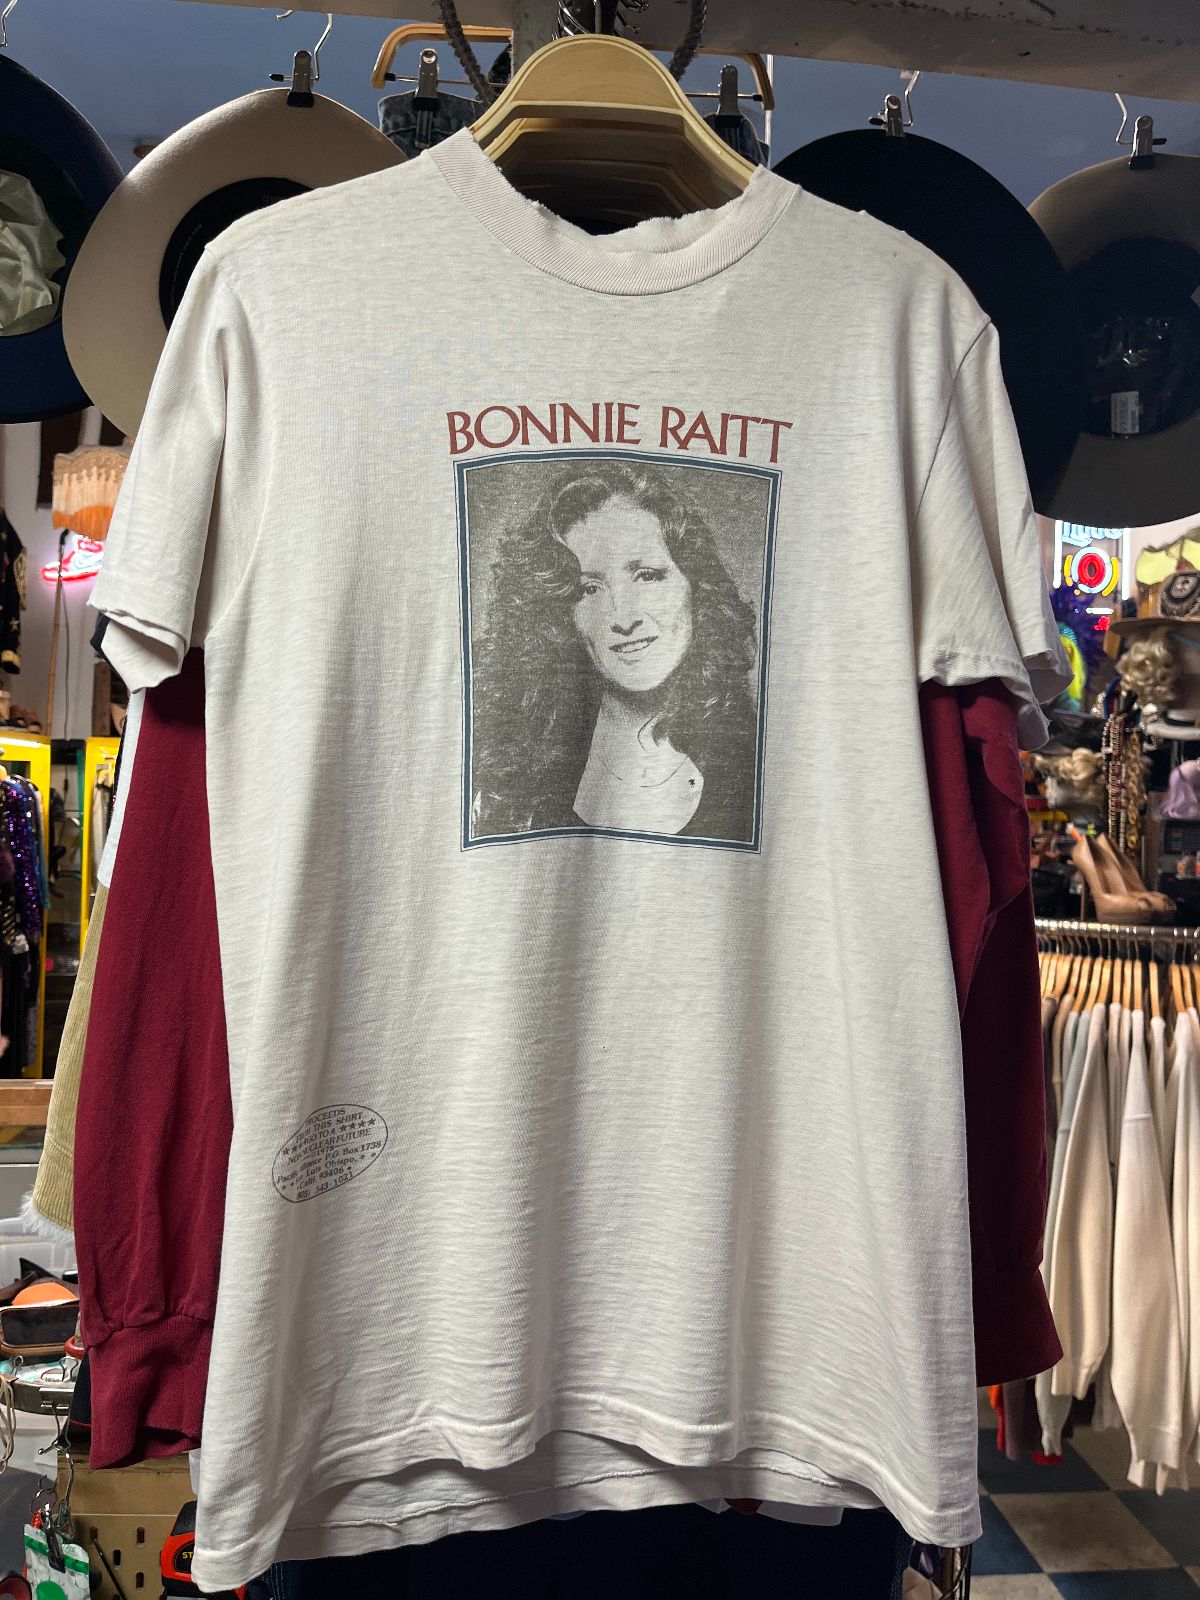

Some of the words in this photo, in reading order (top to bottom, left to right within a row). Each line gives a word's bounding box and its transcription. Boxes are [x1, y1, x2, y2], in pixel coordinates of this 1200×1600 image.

[446, 402, 641, 454] BONNIE
[659, 405, 793, 463] RAITT
[314, 1120, 332, 1130] THIS
[336, 1112, 363, 1126] SHIRT
[336, 1128, 371, 1143] FUTURE
[343, 1146, 359, 1154] Box
[360, 1141, 382, 1151] 1738
